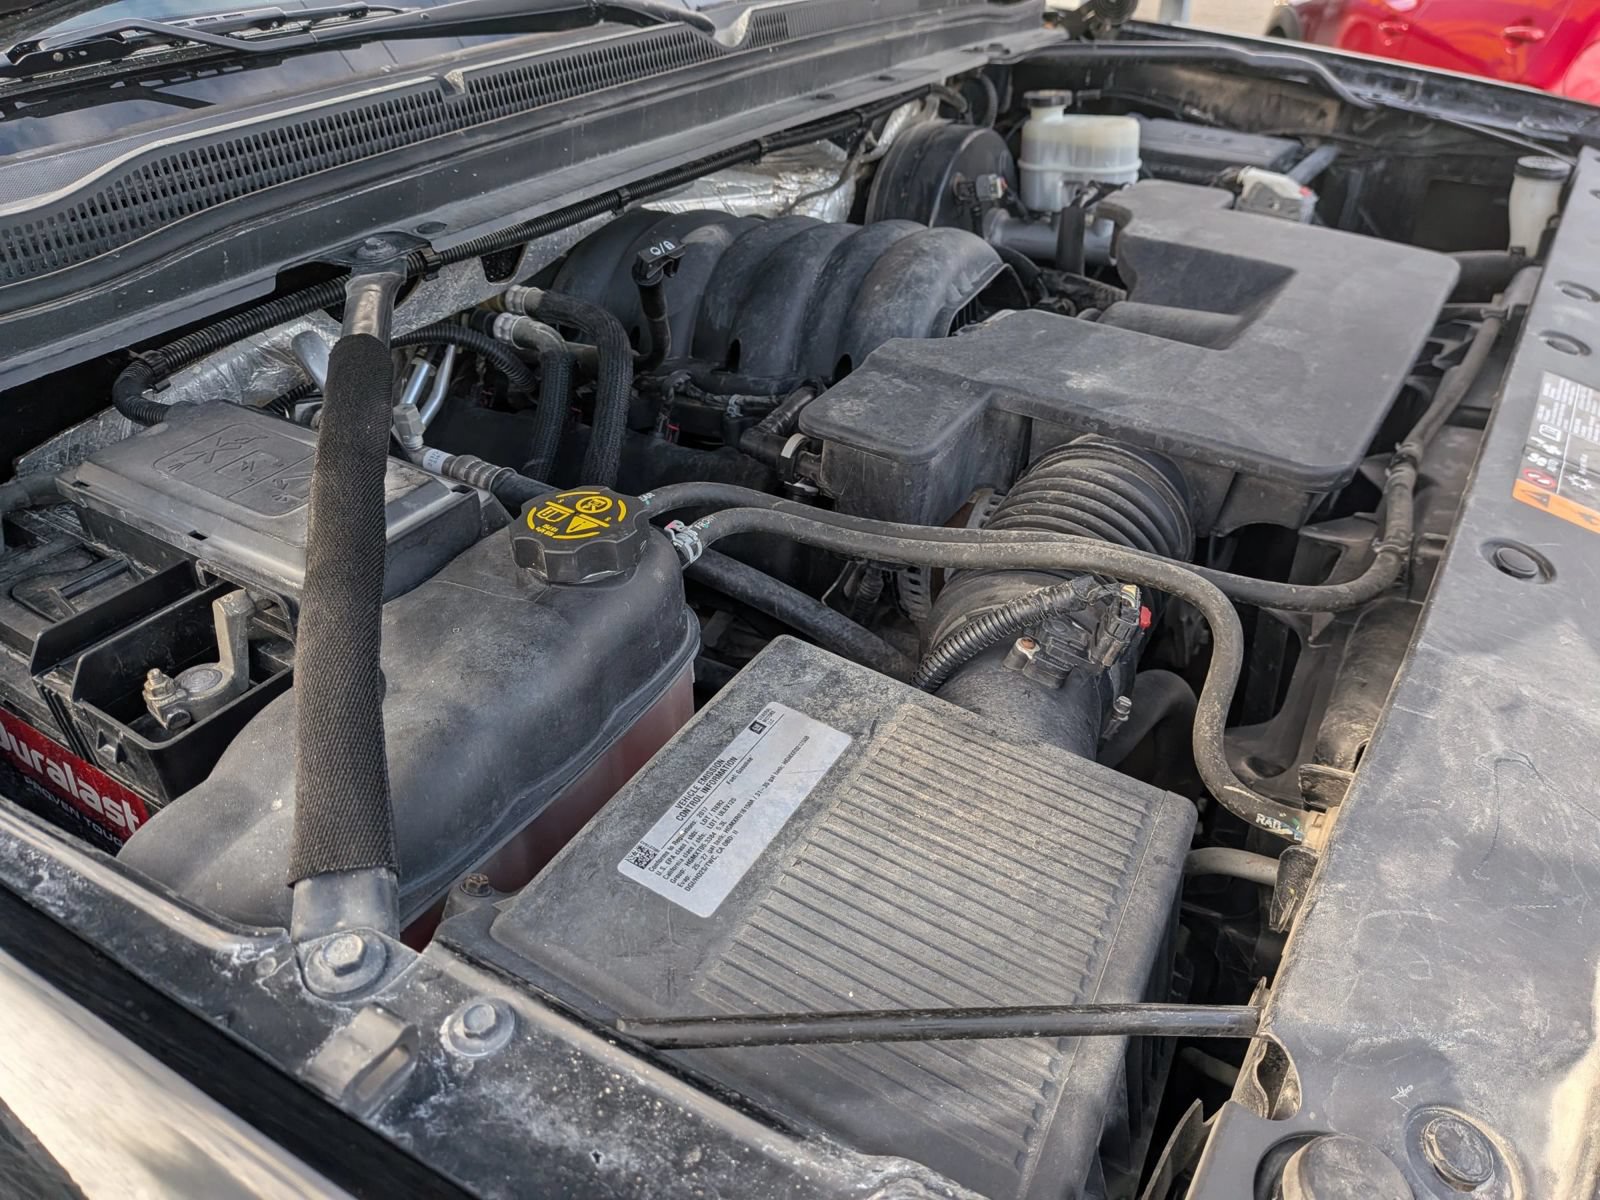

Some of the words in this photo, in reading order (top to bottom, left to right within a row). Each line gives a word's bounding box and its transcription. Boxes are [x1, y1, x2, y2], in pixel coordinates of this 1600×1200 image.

[735, 757, 753, 774] Gasoline
[675, 785, 700, 809] VEHICLE
[697, 758, 725, 785] EMISSION
[675, 793, 704, 822] CONTROL
[700, 756, 738, 794] INFORMATION
[83, 817, 123, 848] TOUG
[665, 854, 676, 865] EPA
[674, 843, 687, 855] class
[700, 816, 711, 825] LDT
[648, 850, 669, 872] Conforms
[663, 858, 684, 880] California
[682, 846, 694, 858] class
[707, 819, 717, 829] LDT
[716, 846, 725, 854] CA
[670, 867, 687, 884] Group:
